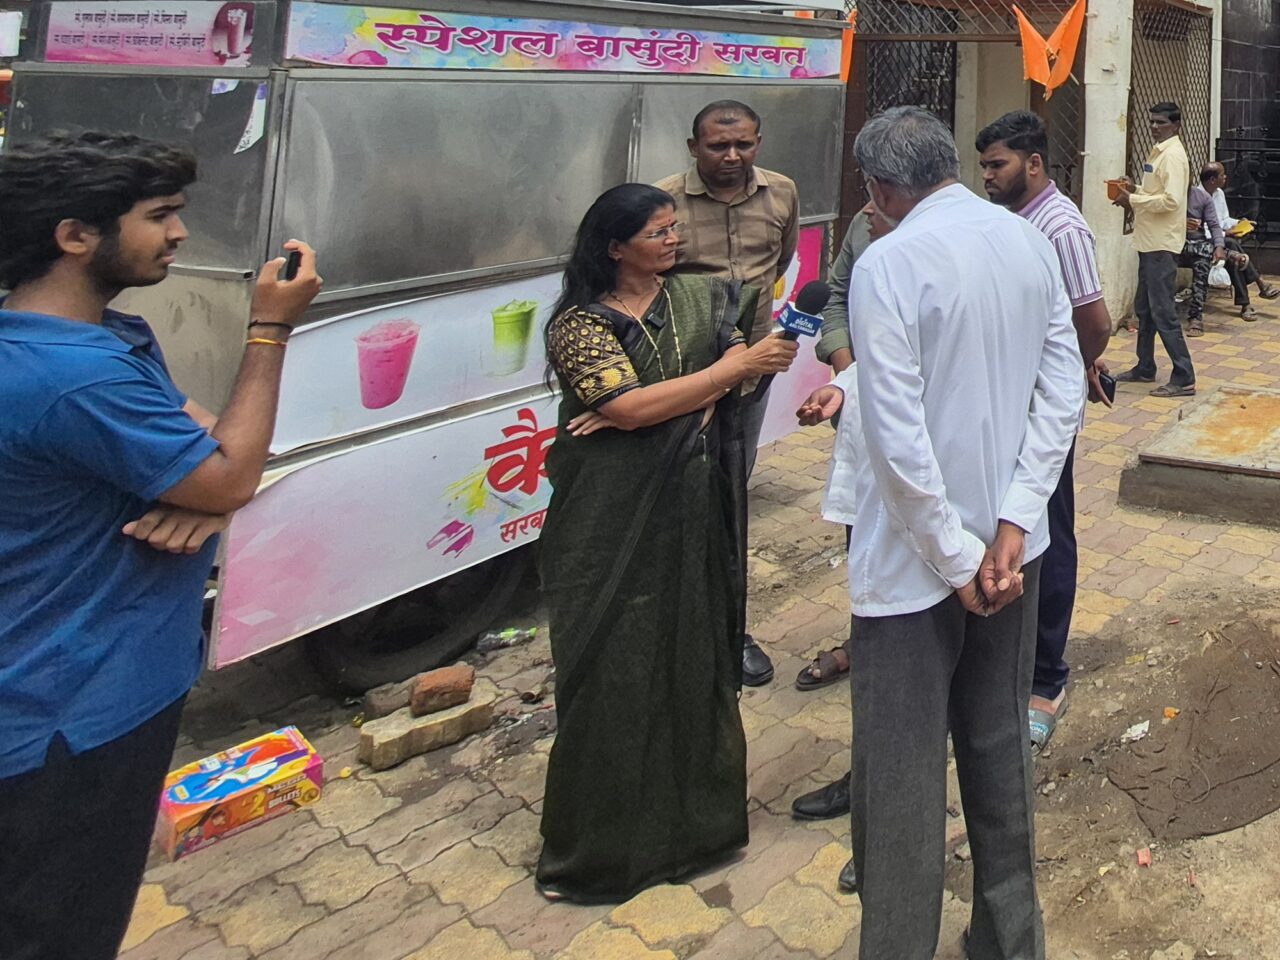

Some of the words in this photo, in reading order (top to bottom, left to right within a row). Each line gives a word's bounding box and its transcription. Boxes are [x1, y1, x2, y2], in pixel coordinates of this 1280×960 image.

[374, 14, 558, 58] स्पेशल
[575, 28, 703, 68] बासुंदी
[713, 41, 807, 66] सरबत
[500, 508, 548, 543] सरब
